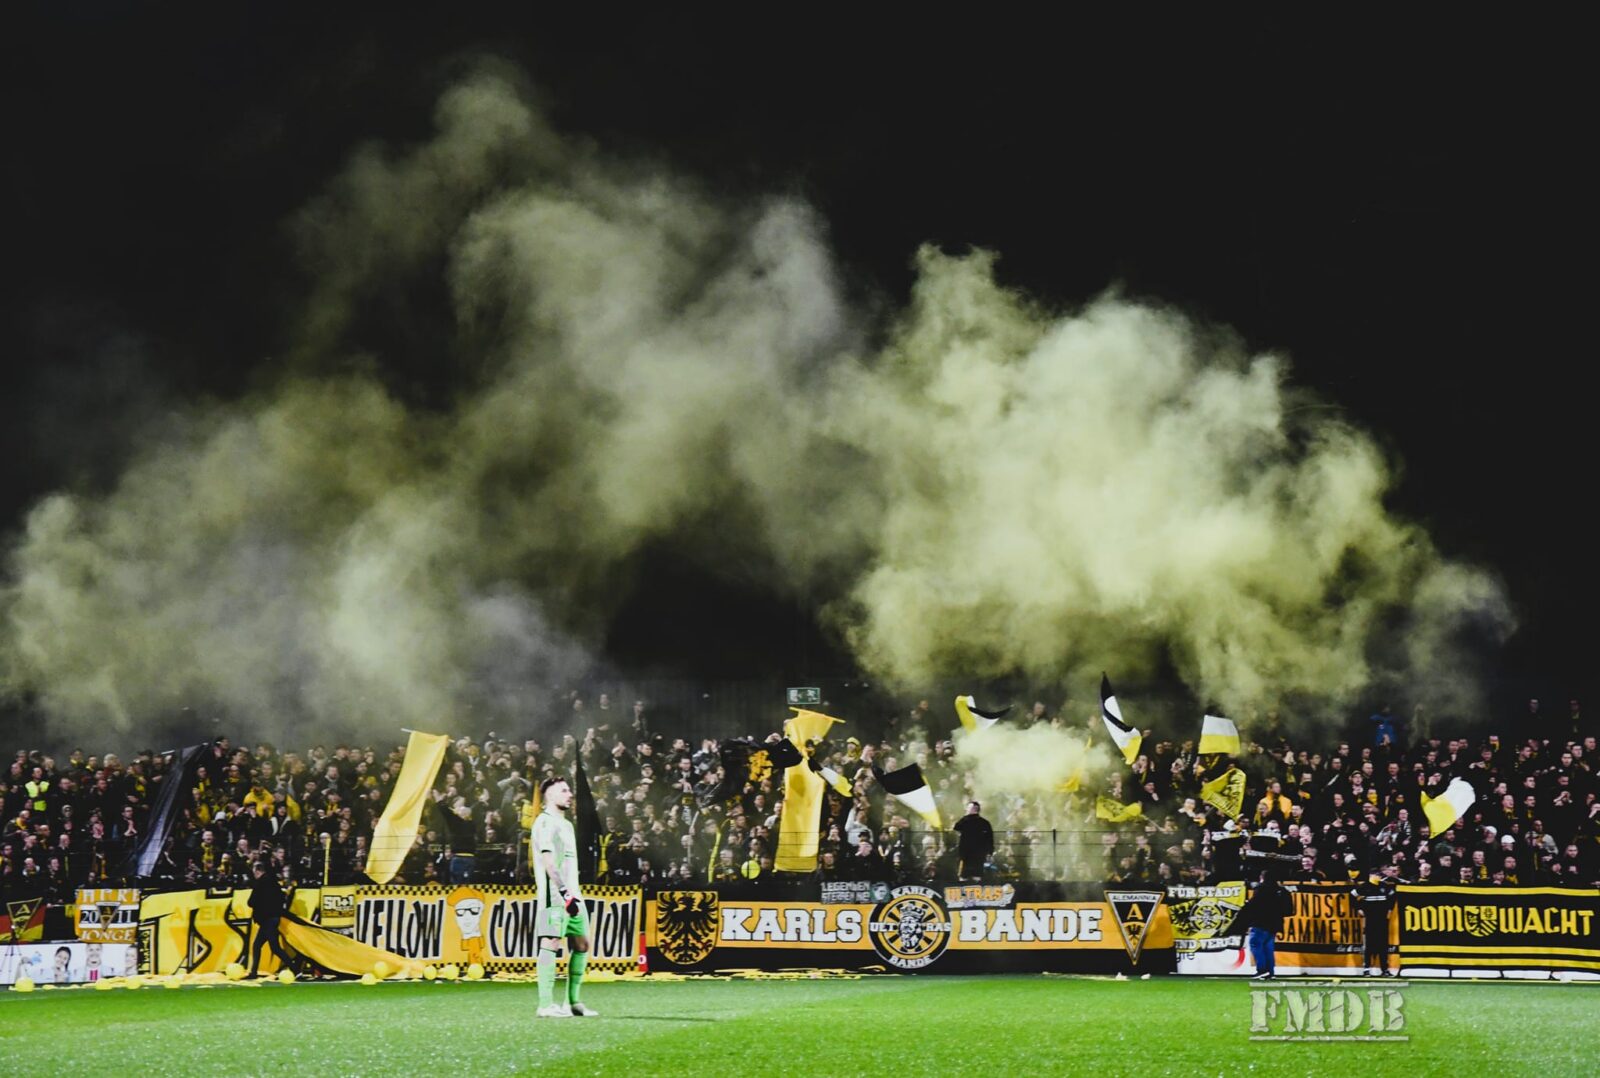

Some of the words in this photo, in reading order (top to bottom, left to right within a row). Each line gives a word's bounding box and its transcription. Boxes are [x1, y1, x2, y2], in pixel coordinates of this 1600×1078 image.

[944, 885, 1004, 901] ULTRAS
[1167, 884, 1197, 898] FÜR
[1198, 886, 1241, 897] STADT
[82, 911, 99, 924] 20
[1126, 903, 1144, 920] A
[356, 899, 444, 958] YELLOW
[490, 899, 637, 957] CONTION
[720, 907, 863, 943] KARLS
[958, 908, 1103, 942] BANDE
[1405, 905, 1465, 932] DOM
[1499, 907, 1594, 936] WACHT
[888, 955, 931, 969] BANDE
